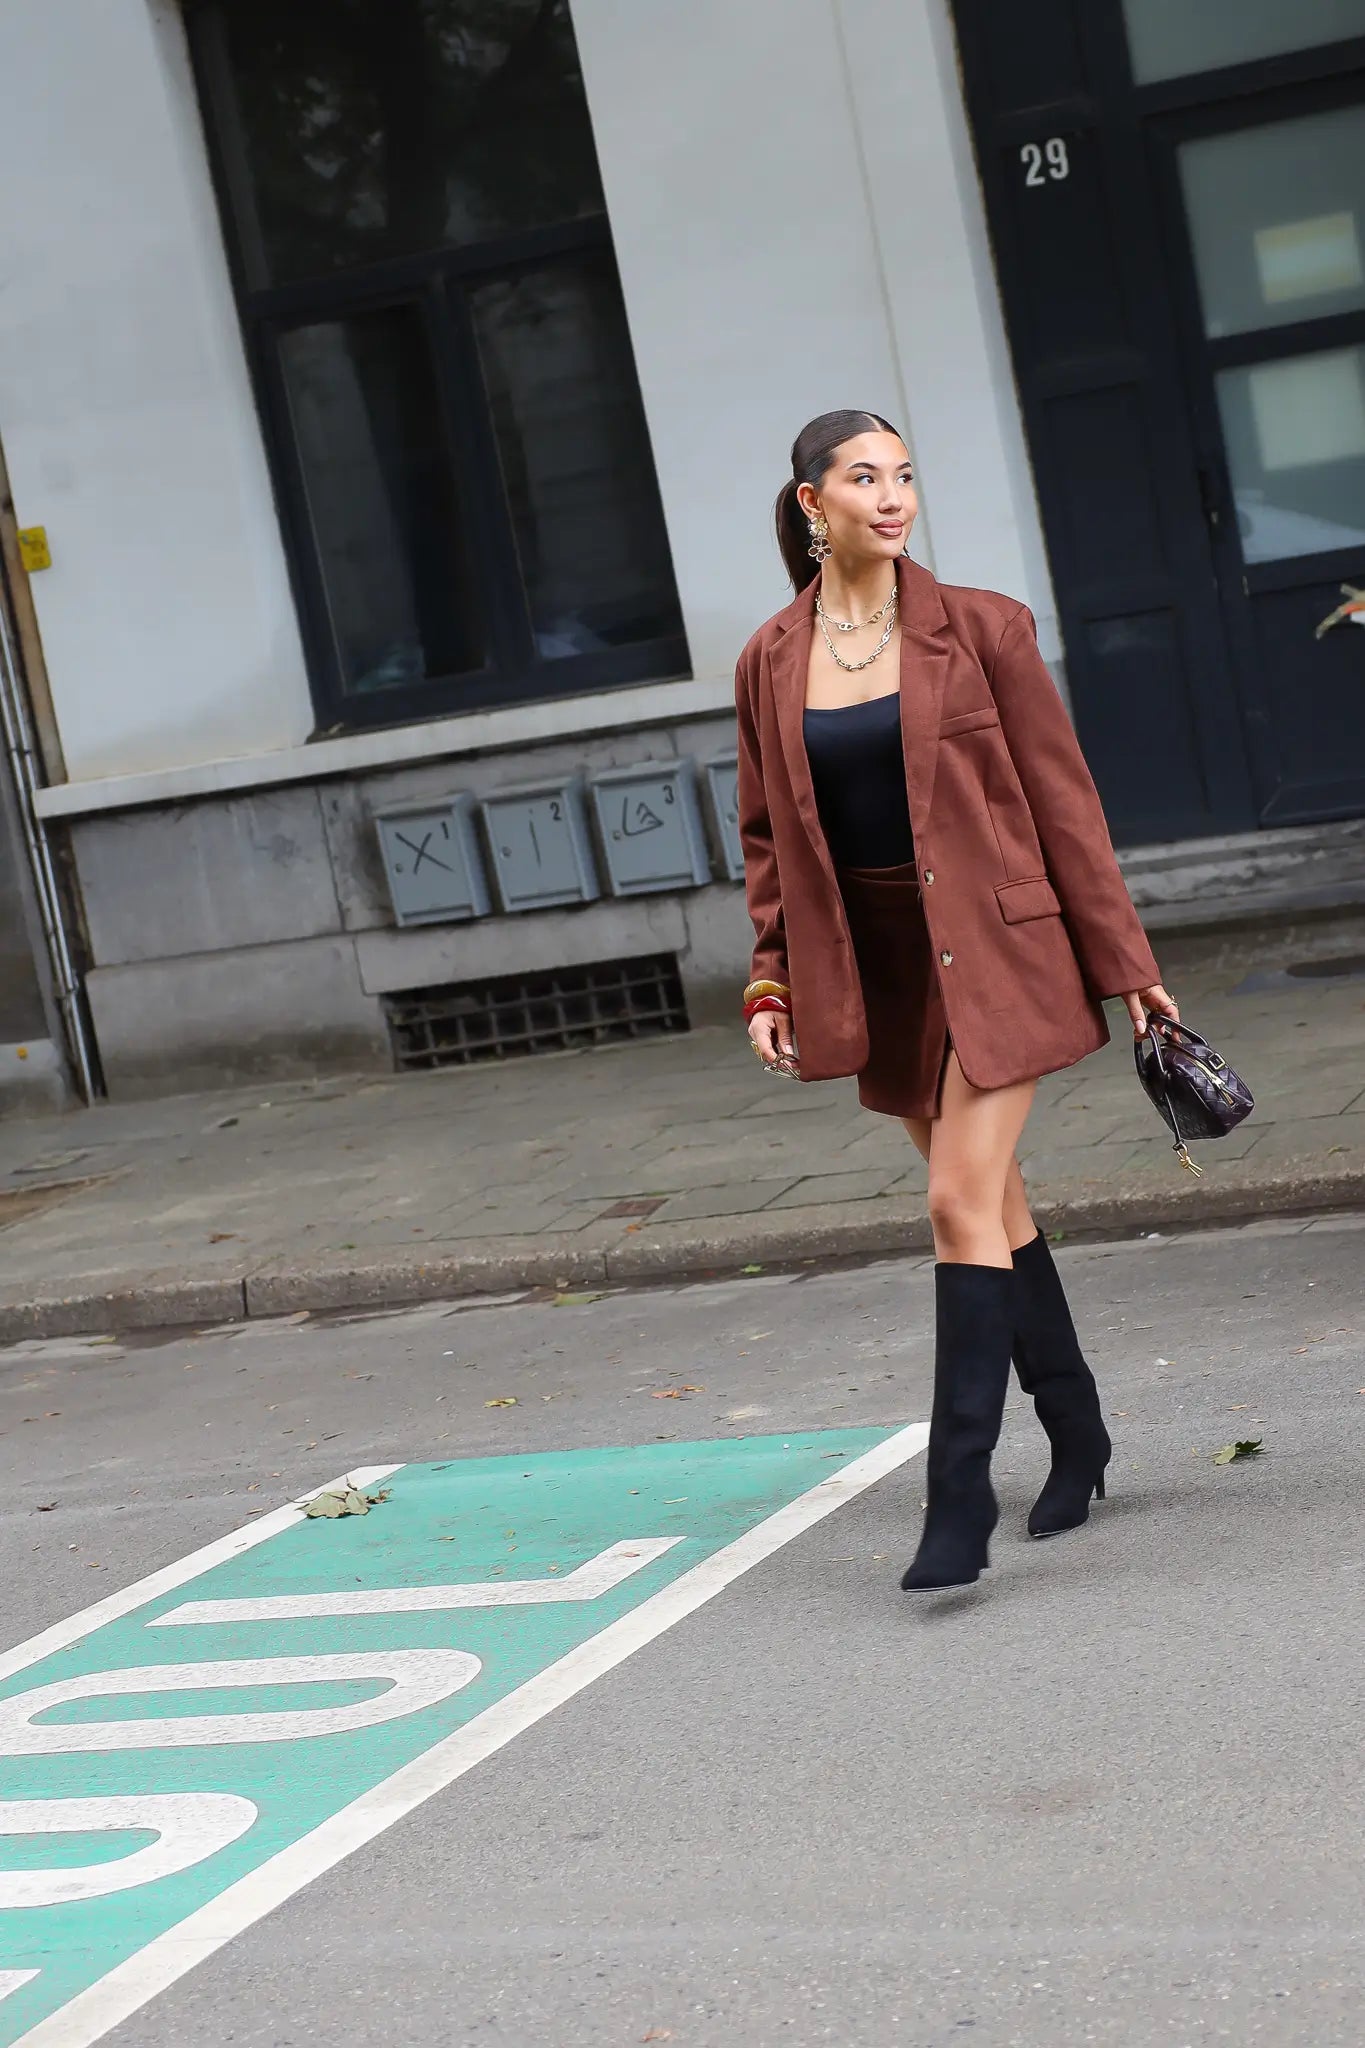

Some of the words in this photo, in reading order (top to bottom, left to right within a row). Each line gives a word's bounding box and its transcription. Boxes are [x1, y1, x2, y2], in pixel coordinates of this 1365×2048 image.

[1020, 137, 1070, 187] 29
[662, 784, 675, 805] 3
[549, 801, 563, 821] 2
[441, 821, 449, 840] 1
